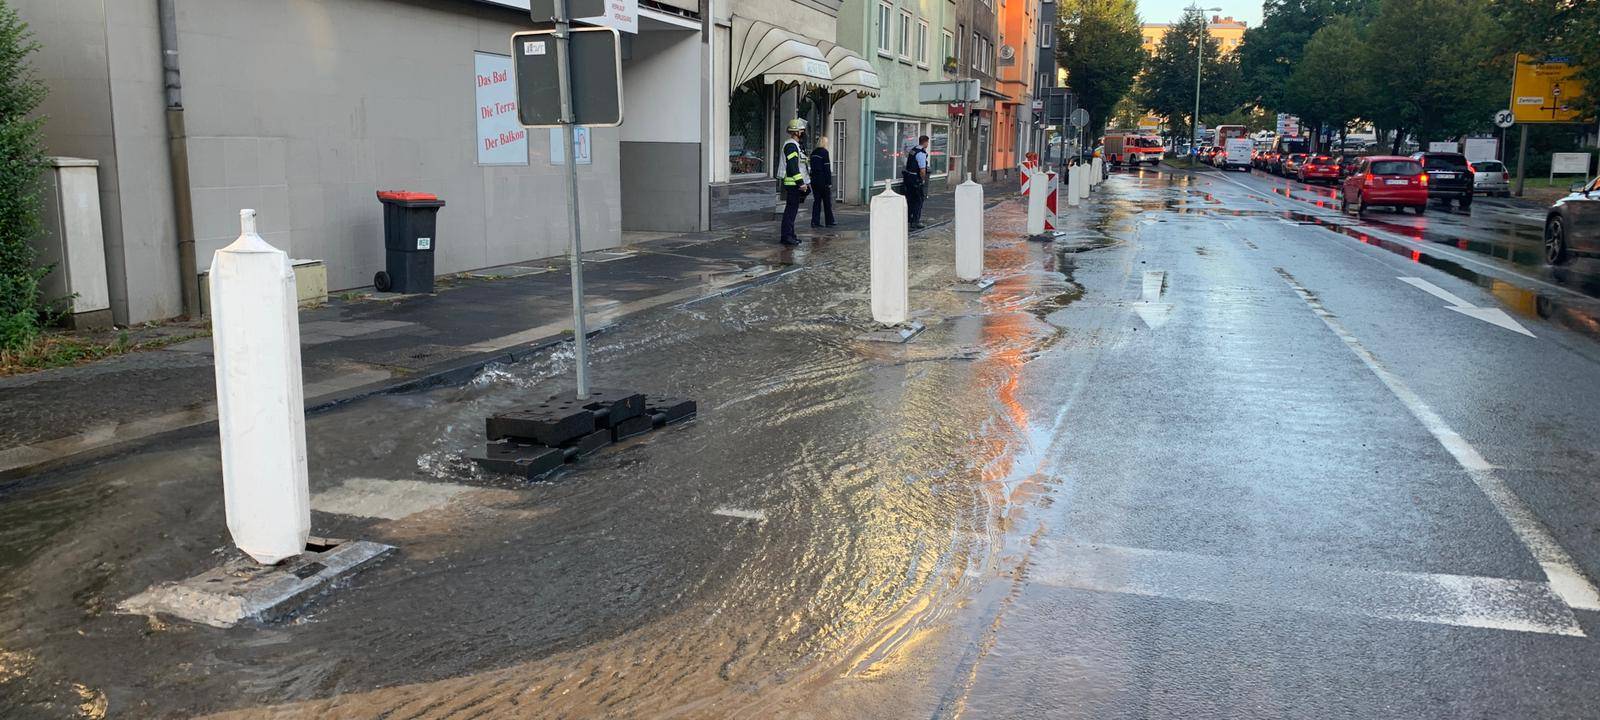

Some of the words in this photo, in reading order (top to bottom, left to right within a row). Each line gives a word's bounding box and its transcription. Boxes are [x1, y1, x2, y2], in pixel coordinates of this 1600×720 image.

[477, 75, 491, 87] Das
[493, 70, 507, 84] Bad
[481, 106, 493, 119] Die
[1499, 113, 1513, 124] 30
[484, 138, 499, 151] Der
[500, 130, 525, 146] Balkon
